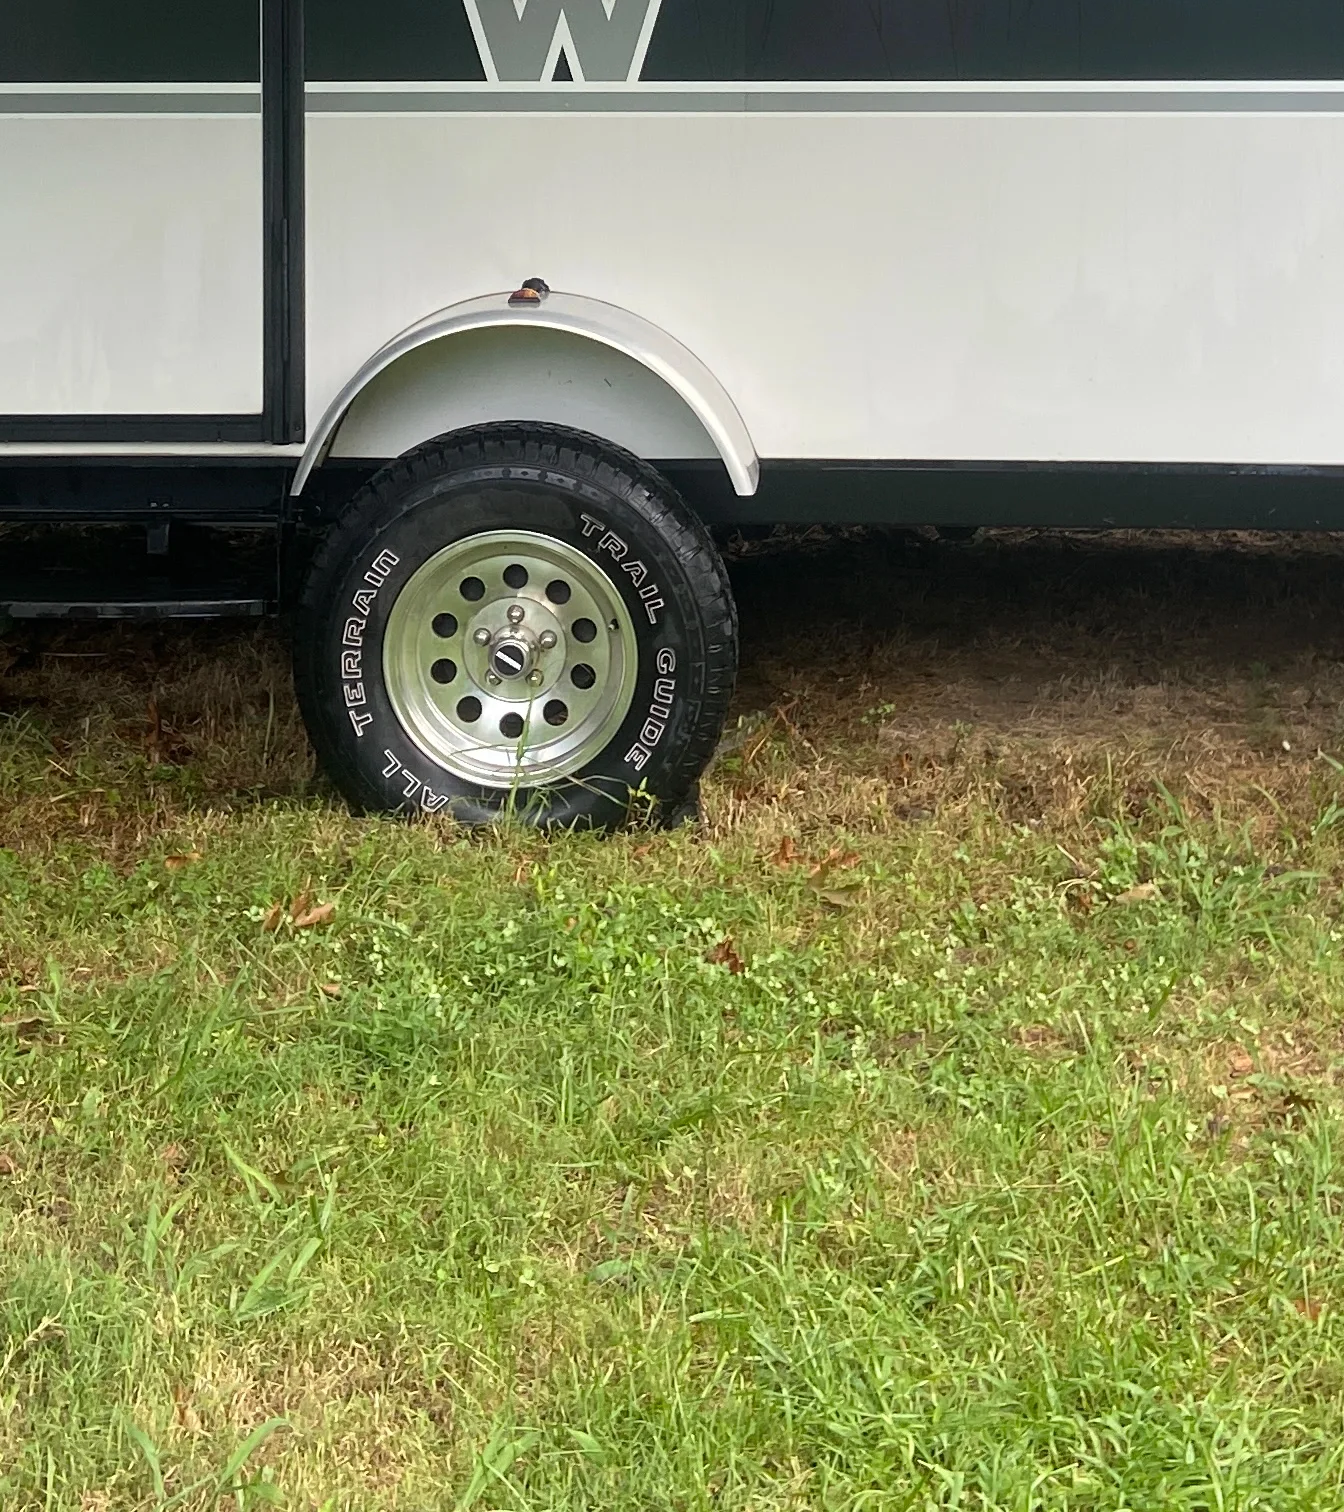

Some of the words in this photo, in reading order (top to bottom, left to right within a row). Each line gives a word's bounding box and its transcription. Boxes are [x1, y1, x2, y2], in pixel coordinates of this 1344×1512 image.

[341, 548, 400, 738] TERRAIN
[579, 512, 666, 626] TRAIL
[624, 646, 677, 772] GUIDE
[381, 749, 450, 813] ALL
